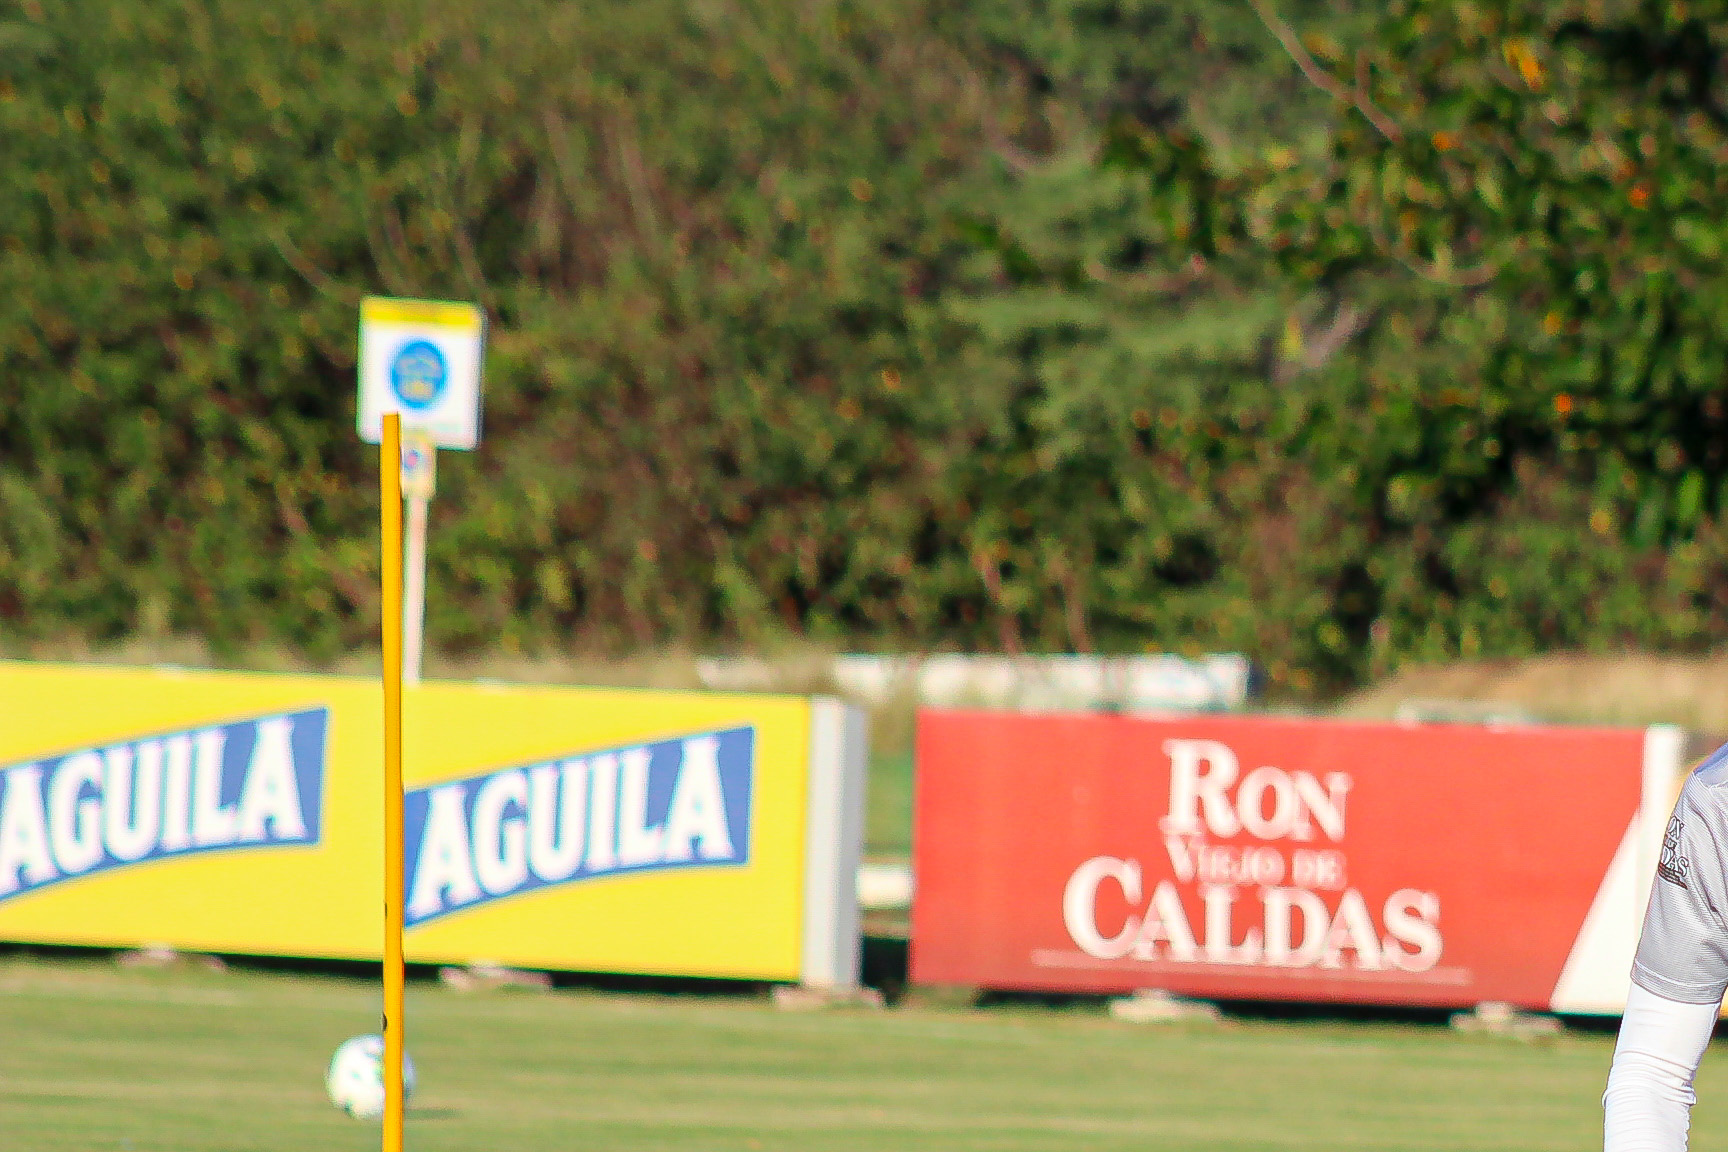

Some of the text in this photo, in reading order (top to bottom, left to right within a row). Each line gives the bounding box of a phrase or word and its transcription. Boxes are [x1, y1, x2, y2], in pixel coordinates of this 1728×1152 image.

[0, 717, 306, 894] AGUILA
[409, 736, 733, 918] AGUILA
[1160, 738, 1351, 842] RON
[1164, 830, 1285, 886] VIEJO
[1291, 848, 1347, 890] DE
[1062, 856, 1443, 972] CALDAS
